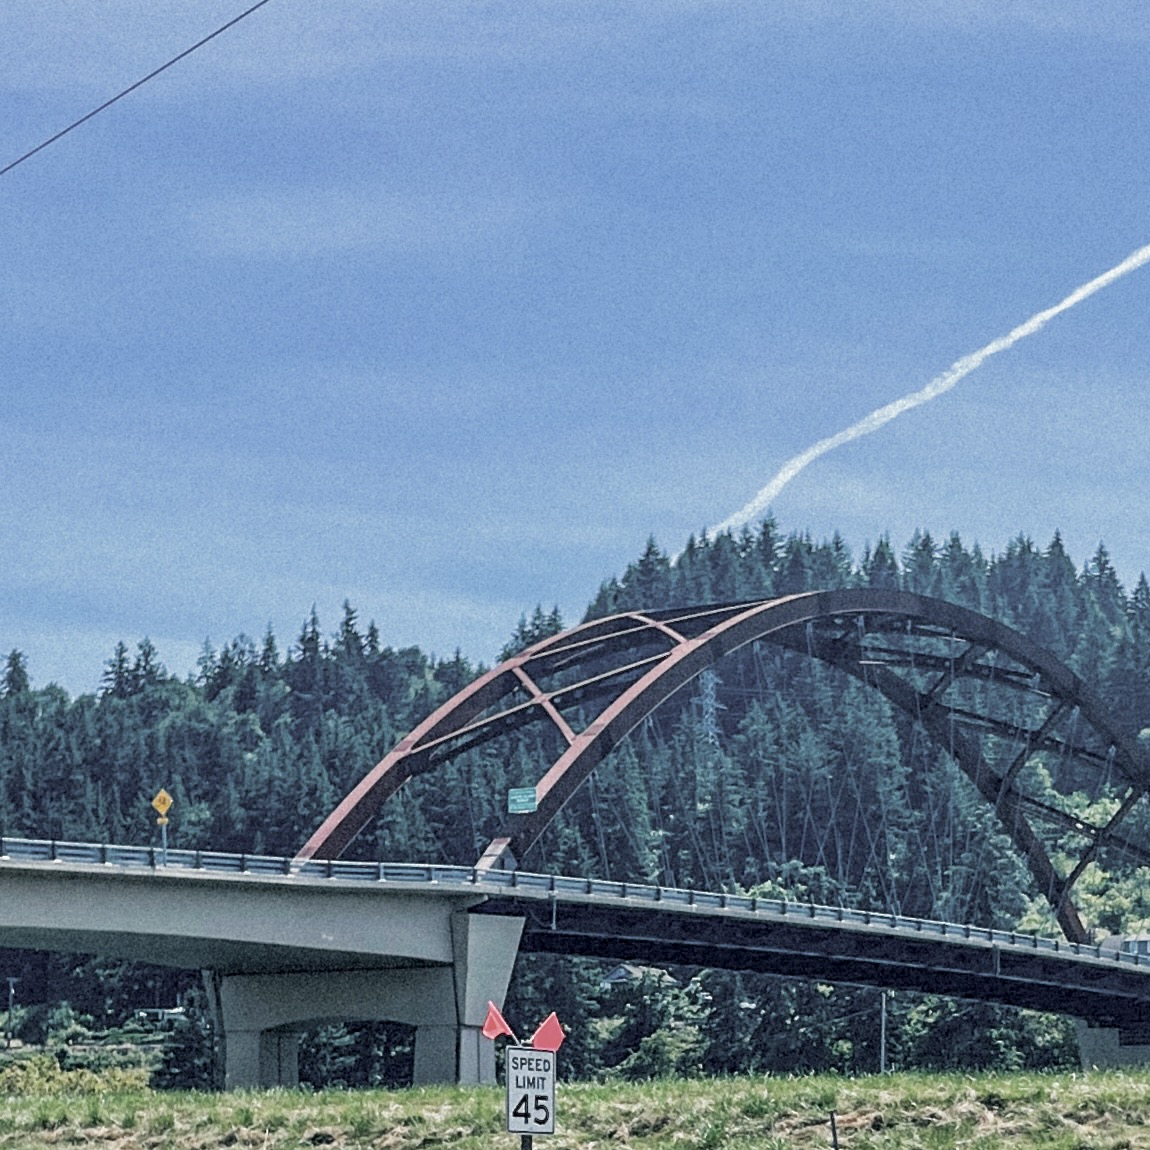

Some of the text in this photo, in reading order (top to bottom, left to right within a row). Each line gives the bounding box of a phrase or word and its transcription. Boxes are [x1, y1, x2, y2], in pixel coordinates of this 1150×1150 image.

[511, 1056, 551, 1073] SPEED
[515, 1075, 547, 1090] LIMIT
[512, 1093, 550, 1126] 45
